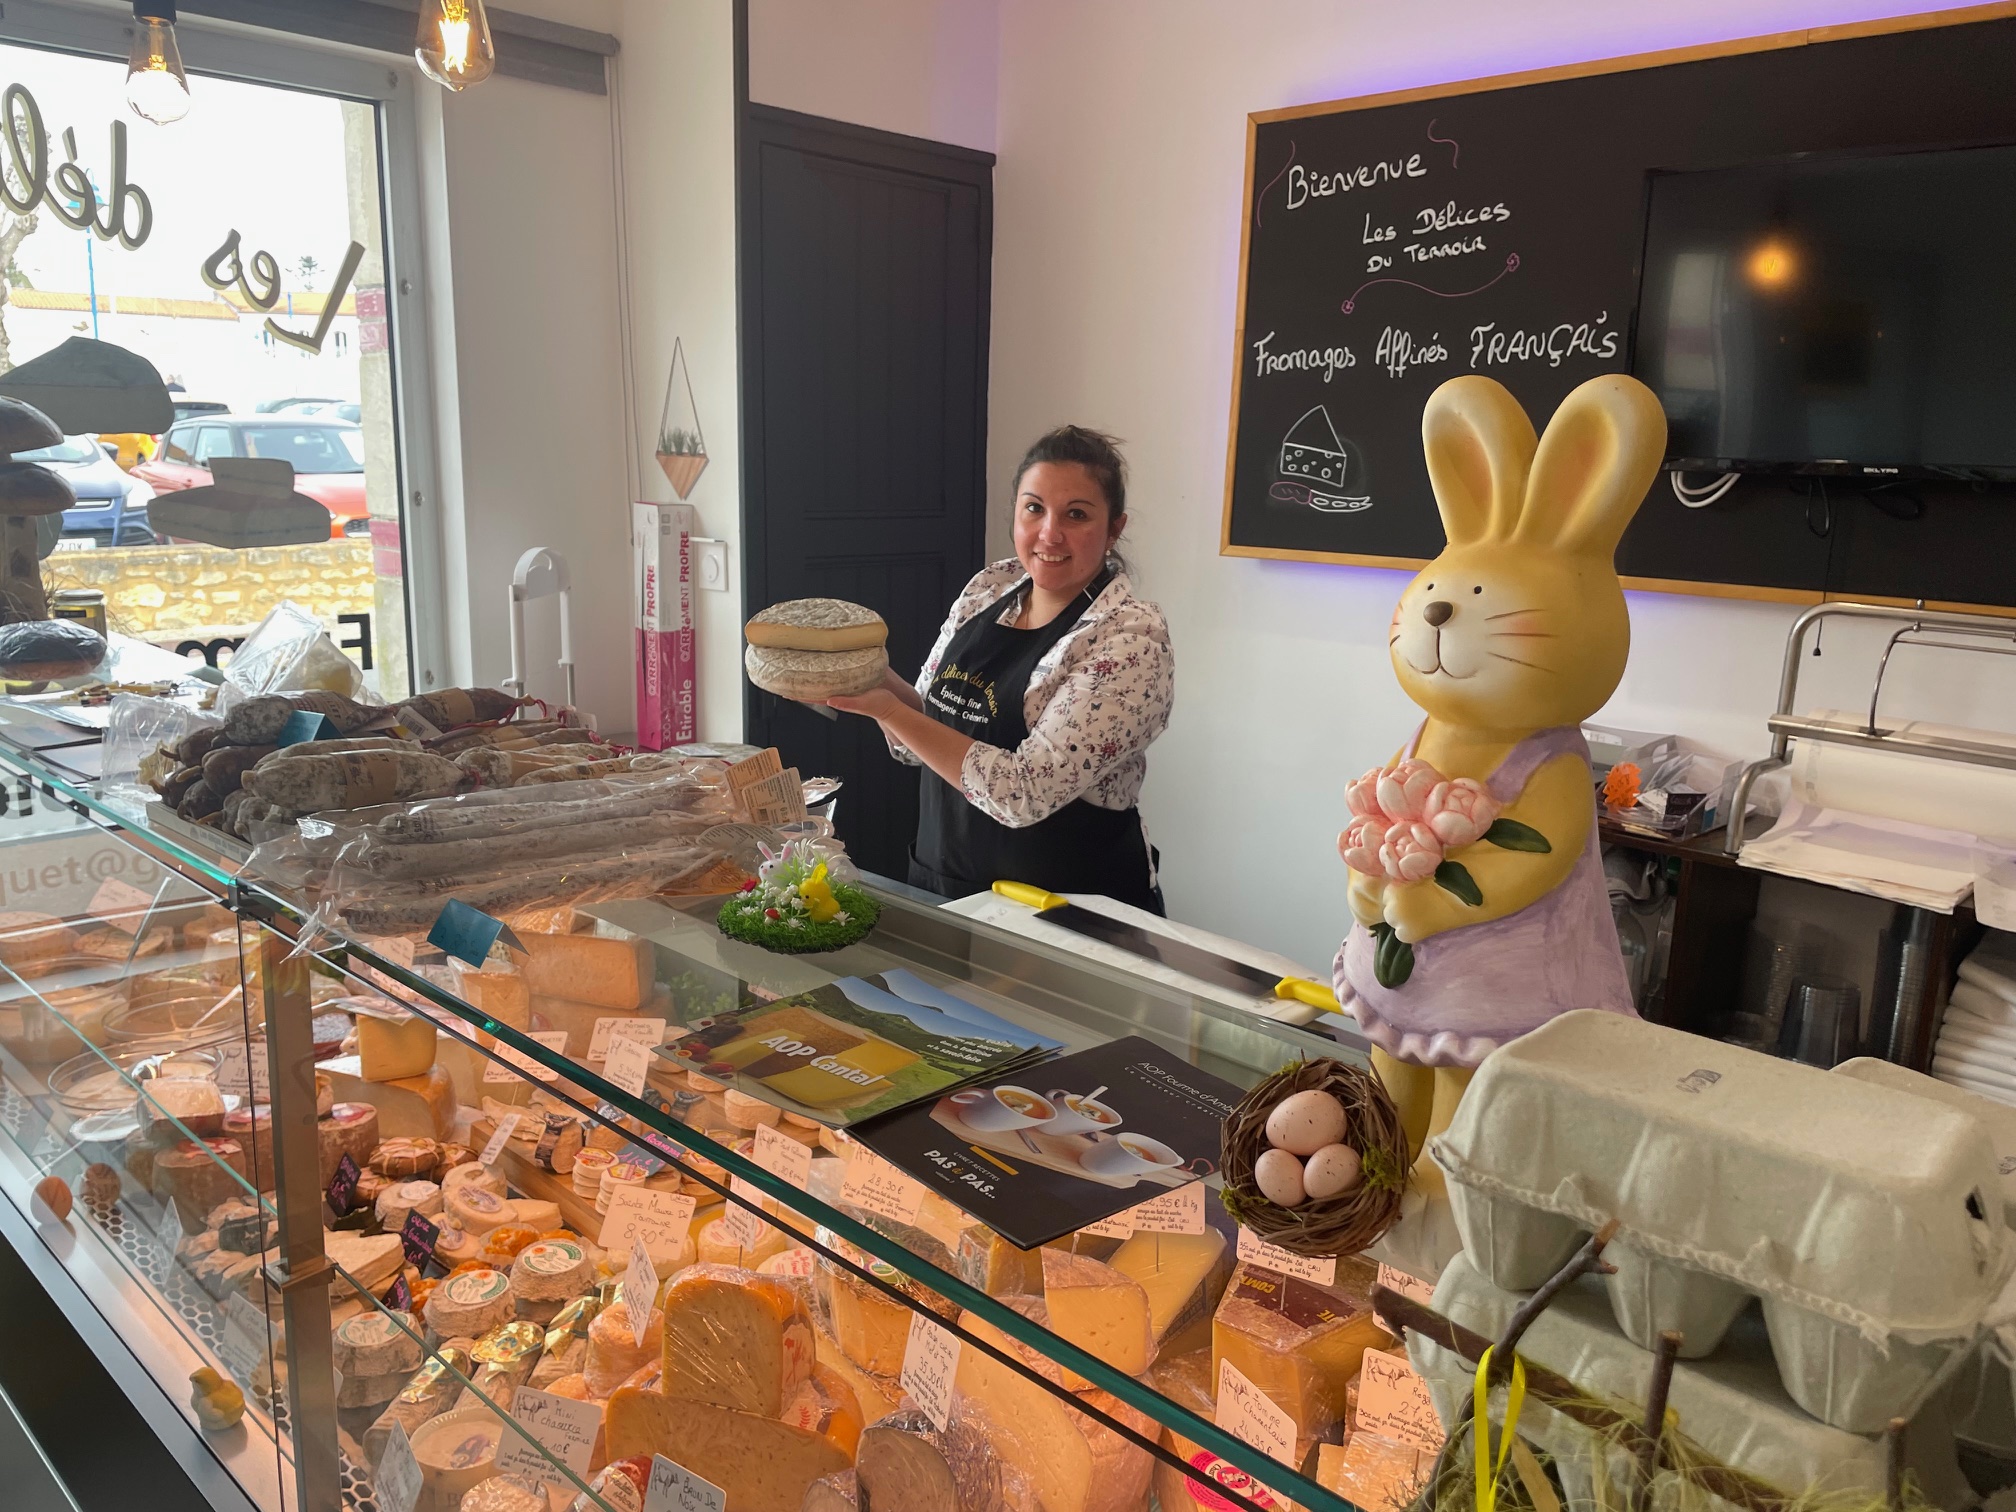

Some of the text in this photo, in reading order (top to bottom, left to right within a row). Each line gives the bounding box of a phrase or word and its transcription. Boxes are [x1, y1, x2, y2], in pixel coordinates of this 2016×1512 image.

[1286, 153, 1428, 210] Bienvenue
[1362, 200, 1511, 245] Les Délices
[1253, 330, 1356, 384] Fromages
[1375, 325, 1449, 379] Affinés
[679, 530, 690, 583] PROPRE
[646, 564, 656, 618] PROPRE
[969, 671, 985, 689] du
[967, 697, 982, 710] fine
[759, 1035, 886, 1087] AOP Cantal
[1137, 1062, 1166, 1075] AOP
[1161, 1074, 1200, 1096] Fourme
[923, 1149, 957, 1169] PAS
[953, 1151, 1001, 1182] LIVRET RECETTES
